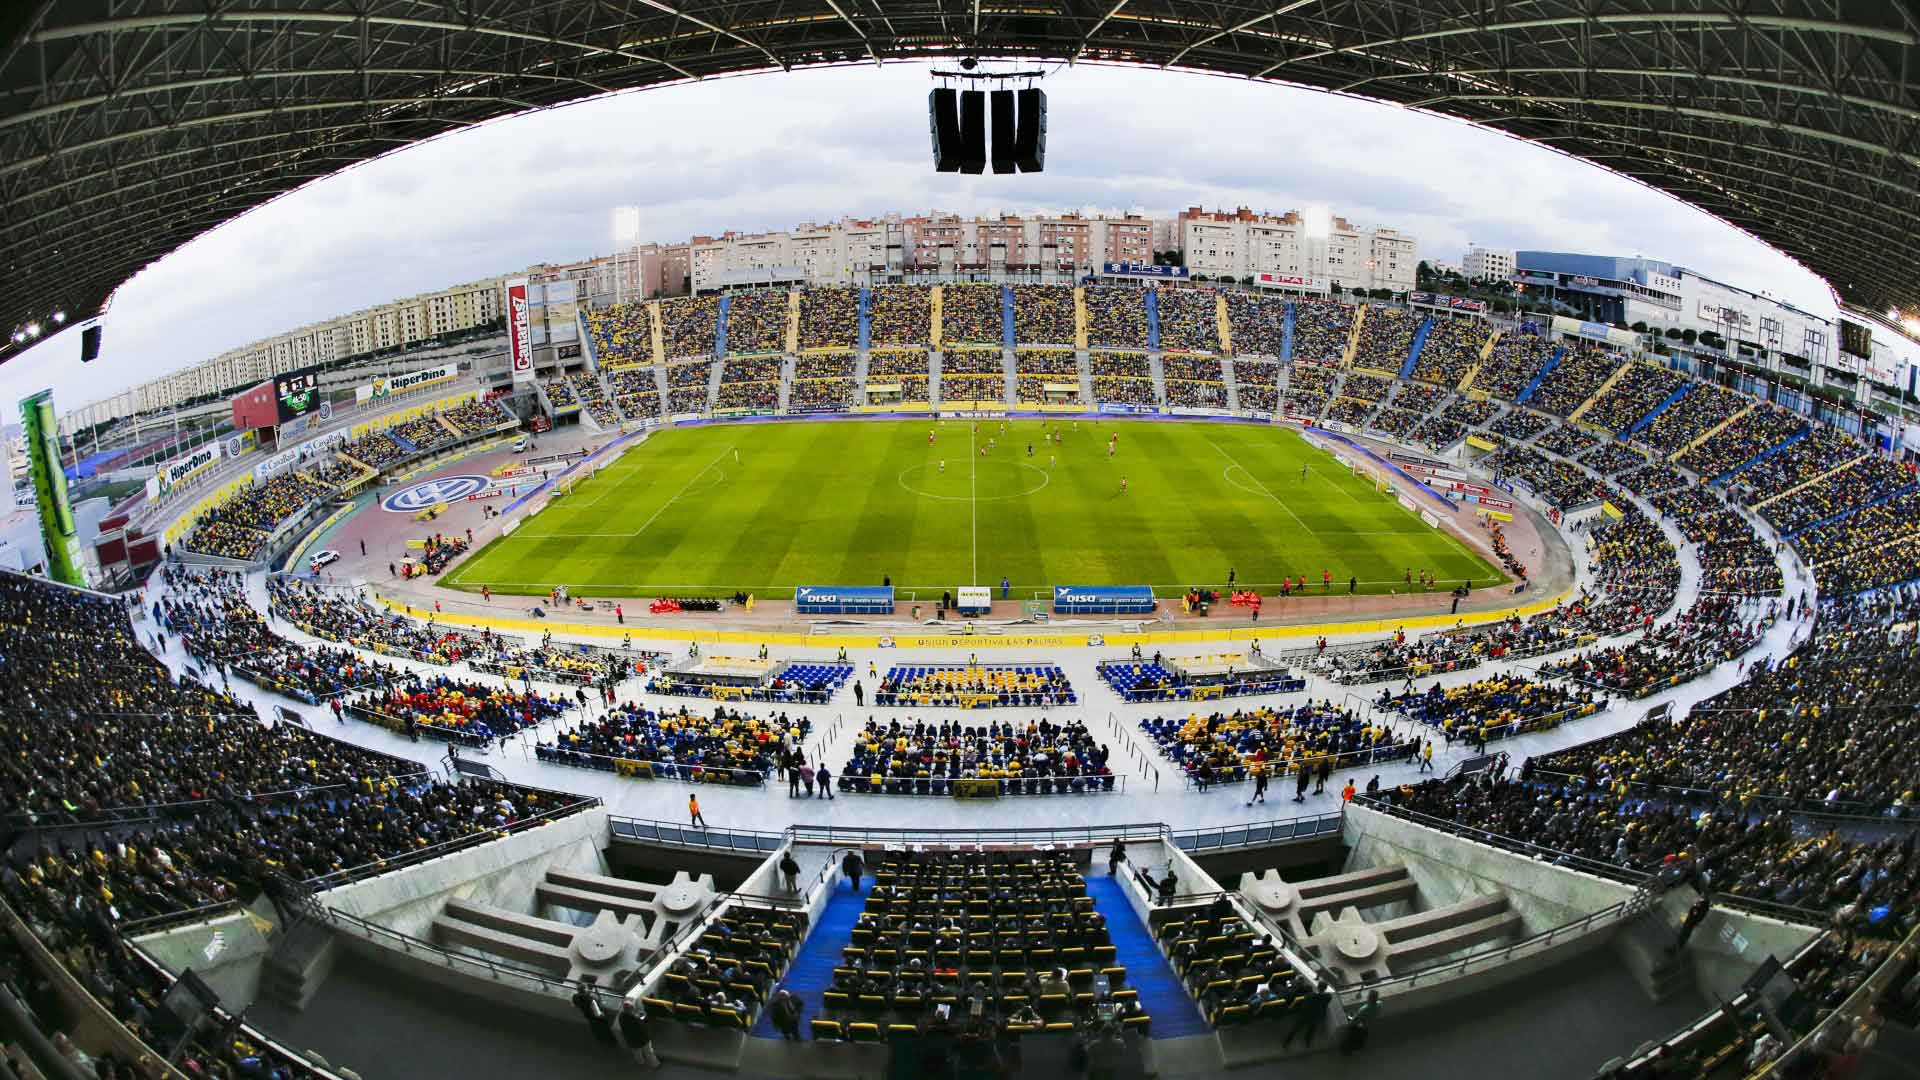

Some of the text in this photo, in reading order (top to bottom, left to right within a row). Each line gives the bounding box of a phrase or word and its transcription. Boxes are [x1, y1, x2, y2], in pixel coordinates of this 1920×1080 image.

[512, 296, 530, 369] Canarias7
[390, 368, 446, 390] HiperDino
[170, 450, 211, 481] HiperDino
[476, 490, 502, 499] MAPFRE
[1027, 638, 1063, 646] PALMAS
